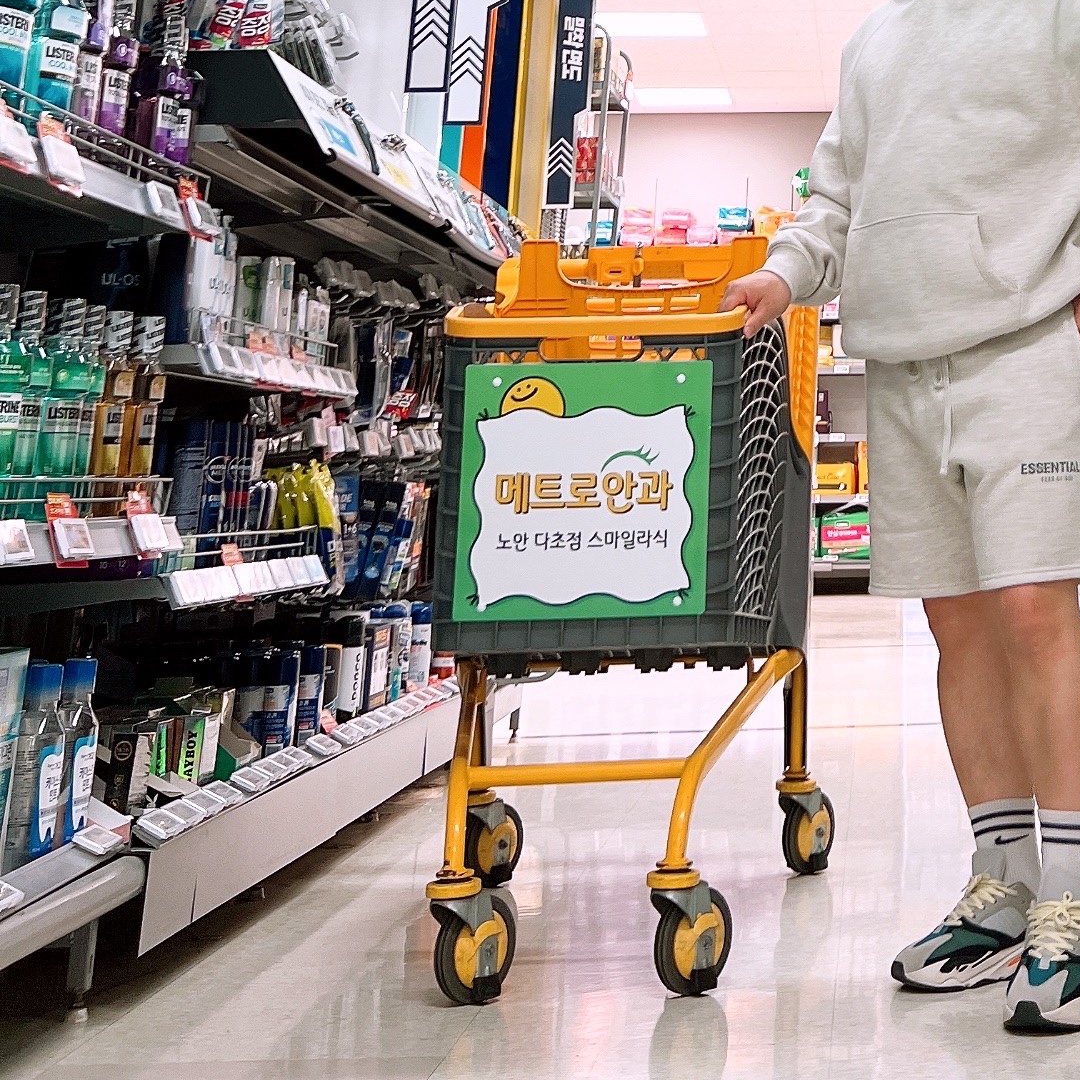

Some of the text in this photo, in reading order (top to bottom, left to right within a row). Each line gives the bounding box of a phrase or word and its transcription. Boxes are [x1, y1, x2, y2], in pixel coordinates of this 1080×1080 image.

[560, 49, 584, 82] 면도
[494, 469, 674, 515] 메트로안과
[495, 528, 669, 551] 노안 다초점 스마일라식
